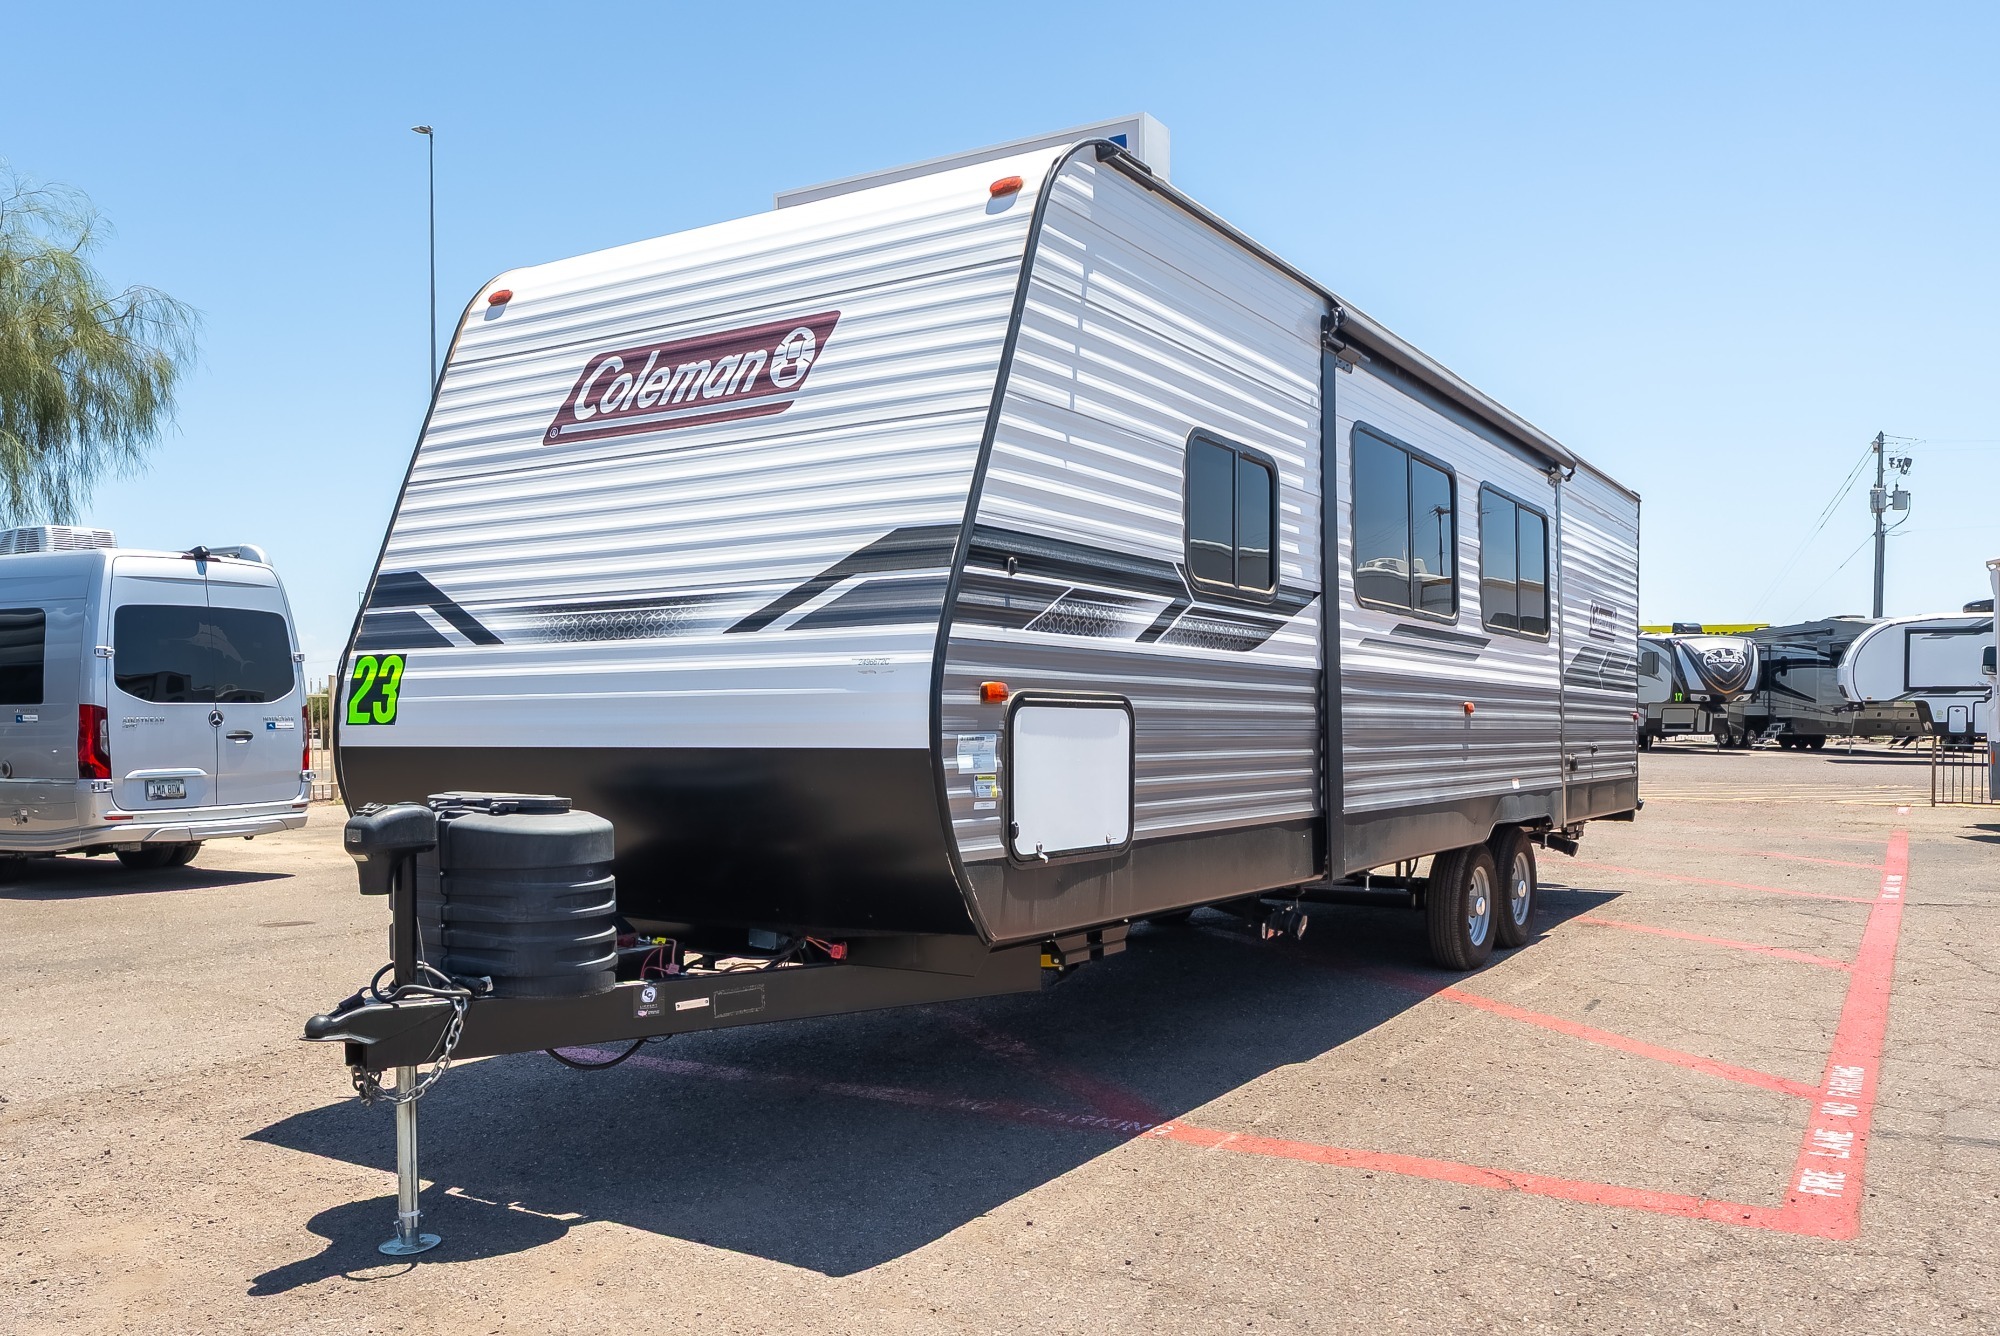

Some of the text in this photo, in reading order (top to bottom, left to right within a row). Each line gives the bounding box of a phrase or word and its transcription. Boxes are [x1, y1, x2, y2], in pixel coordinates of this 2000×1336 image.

[573, 349, 769, 422] Coleman
[347, 654, 404, 724] 23
[1674, 692, 1683, 702] 17
[1797, 1065, 1865, 1198] FIRE LANE NO PARKING
